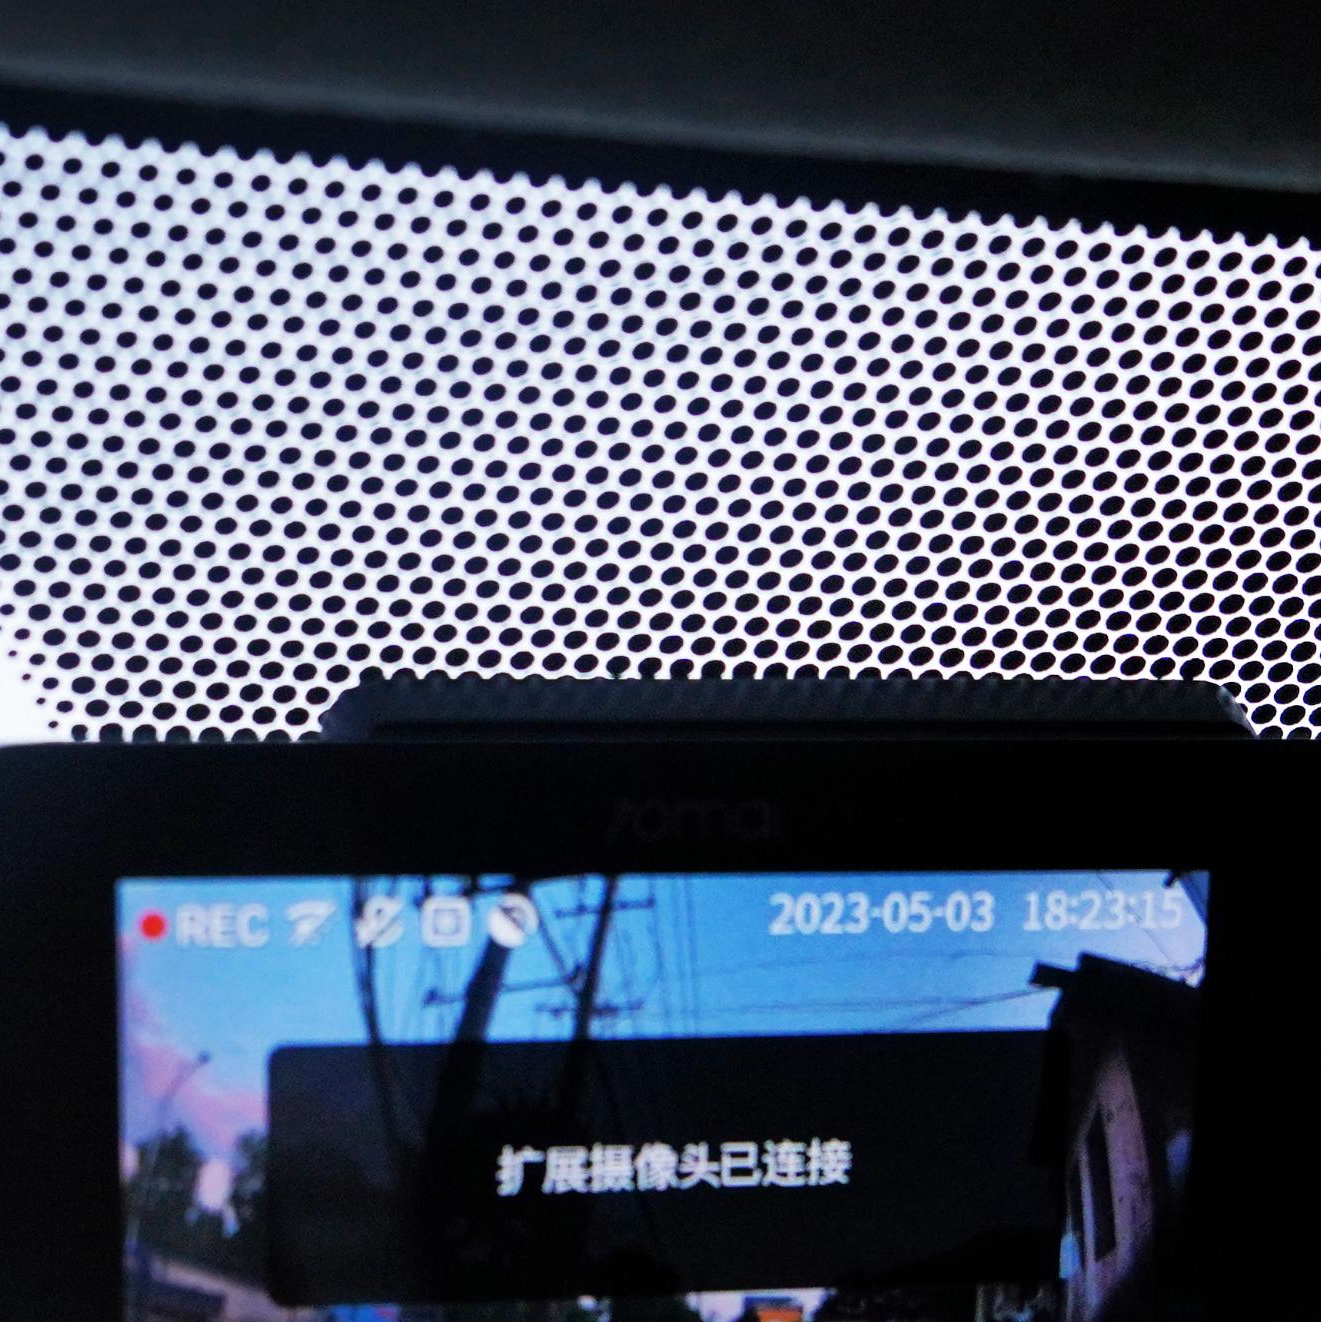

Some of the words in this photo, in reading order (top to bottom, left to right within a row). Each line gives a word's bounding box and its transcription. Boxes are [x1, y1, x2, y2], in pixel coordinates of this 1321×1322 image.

[175, 901, 269, 948] REC
[768, 890, 996, 935] 2023-05-03
[1022, 890, 1183, 932] 18:23:15
[495, 1137, 852, 1196] 扩展摄像头已连接
